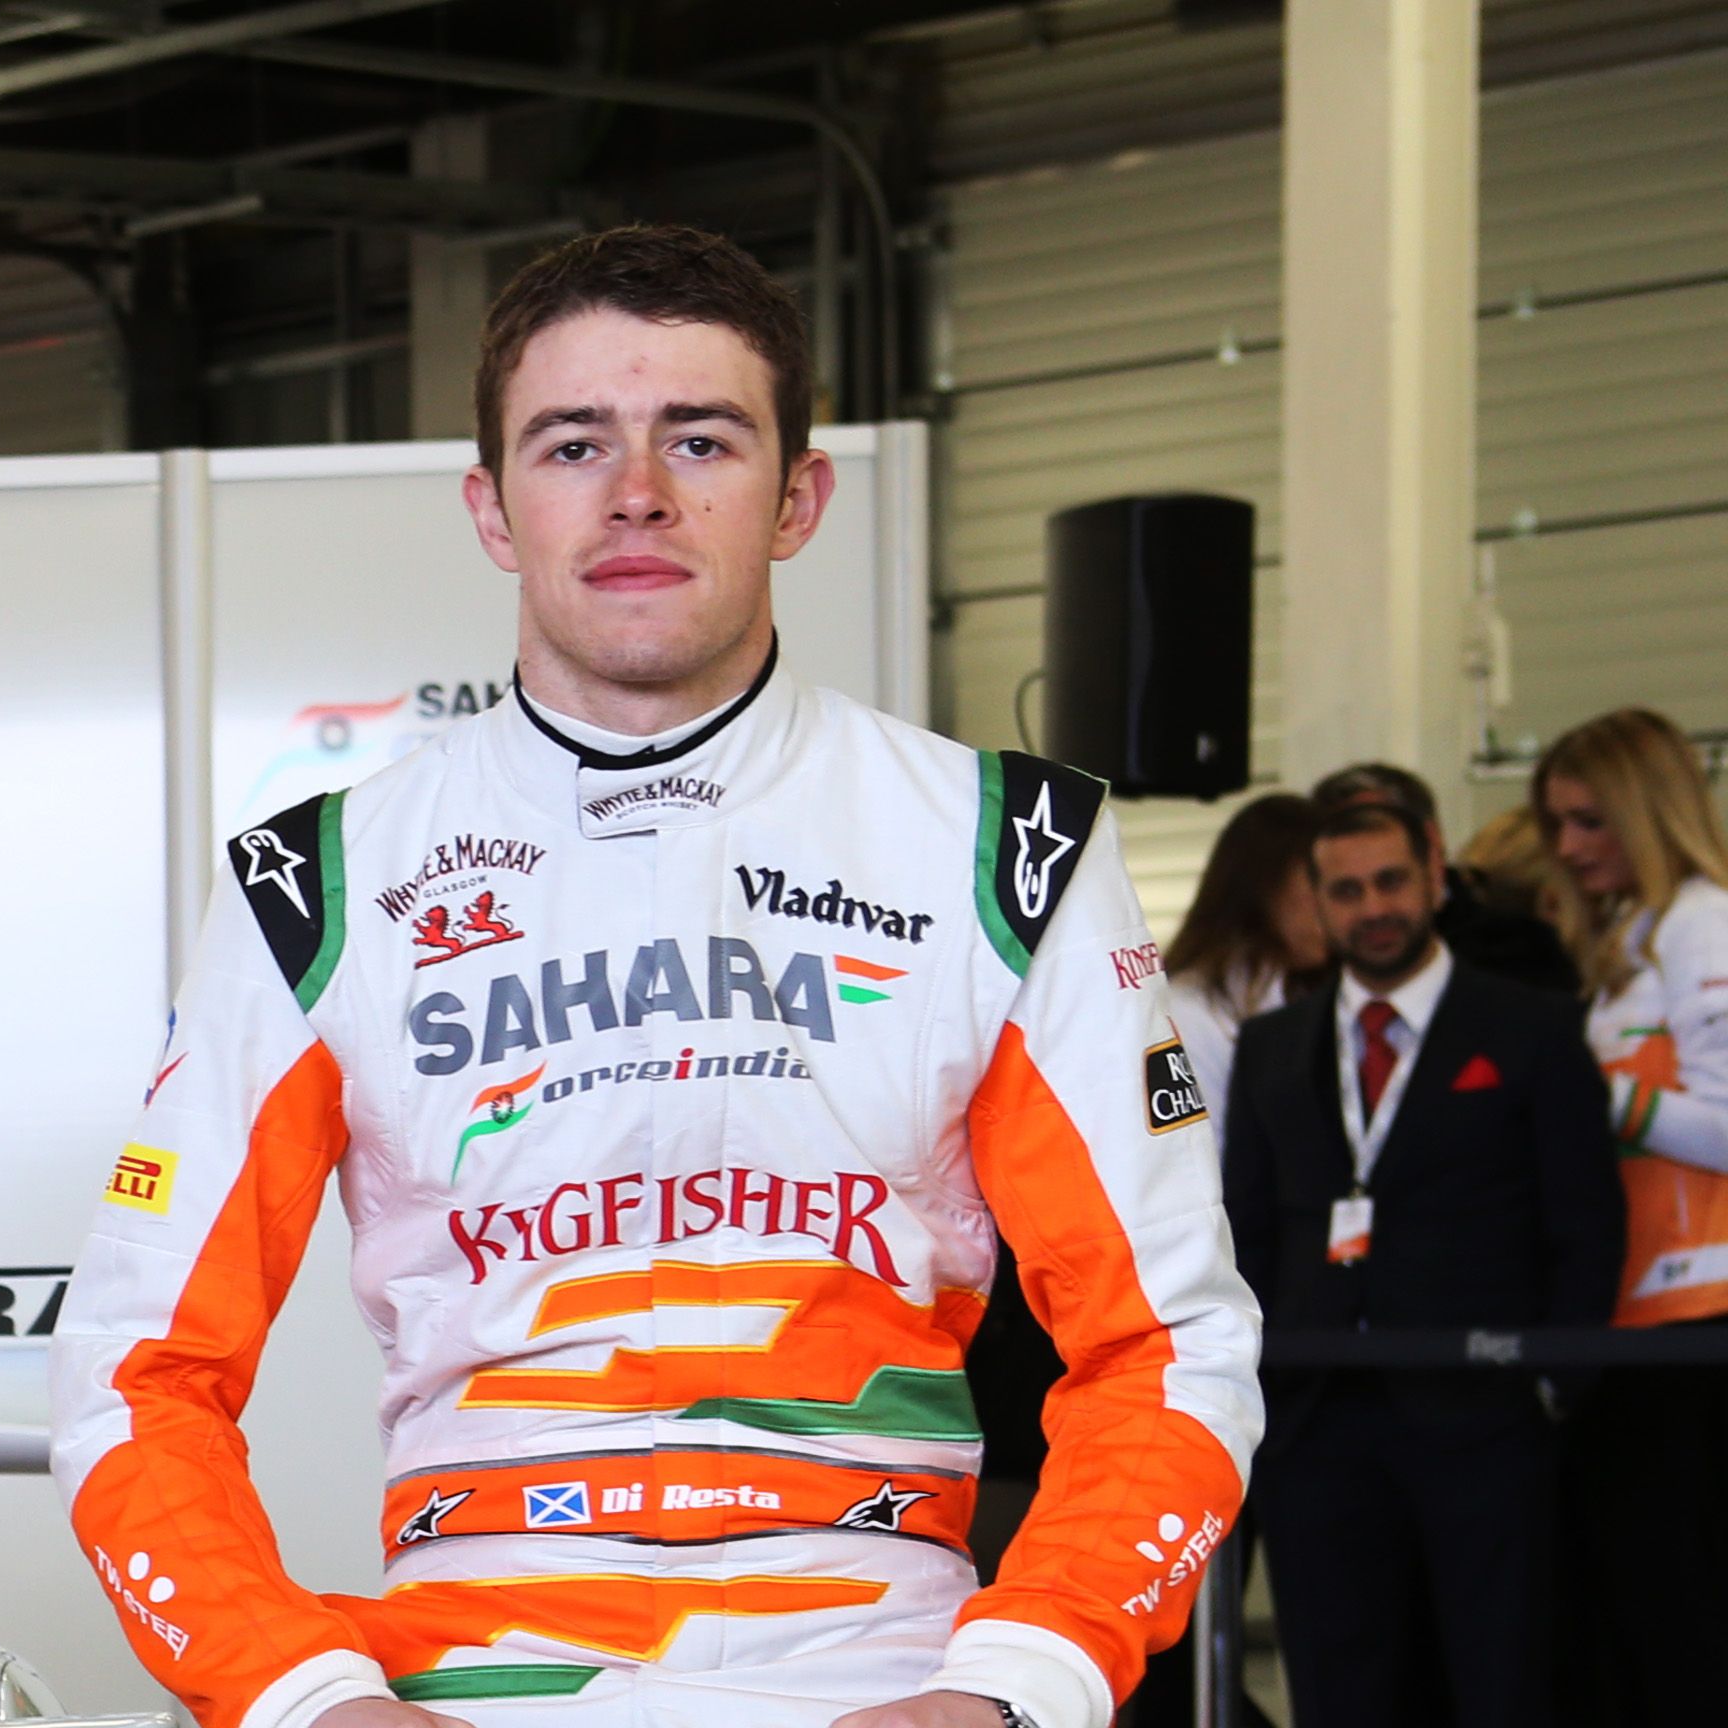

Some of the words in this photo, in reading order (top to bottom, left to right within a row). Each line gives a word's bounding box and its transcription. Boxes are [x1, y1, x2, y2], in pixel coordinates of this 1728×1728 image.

[582, 788, 643, 821] WHYTE
[644, 784, 657, 800] &
[660, 777, 726, 808] MACKAY
[435, 844, 455, 875] &
[455, 833, 546, 876] MACKAY
[423, 875, 488, 898] GLASGOW
[734, 864, 934, 944] Vladivar
[409, 935, 836, 1077] SAHARA
[601, 1481, 643, 1515] Di
[662, 1483, 781, 1512] Resta
[1121, 1578, 1162, 1616] TW
[1168, 1510, 1224, 1587] STEEL
